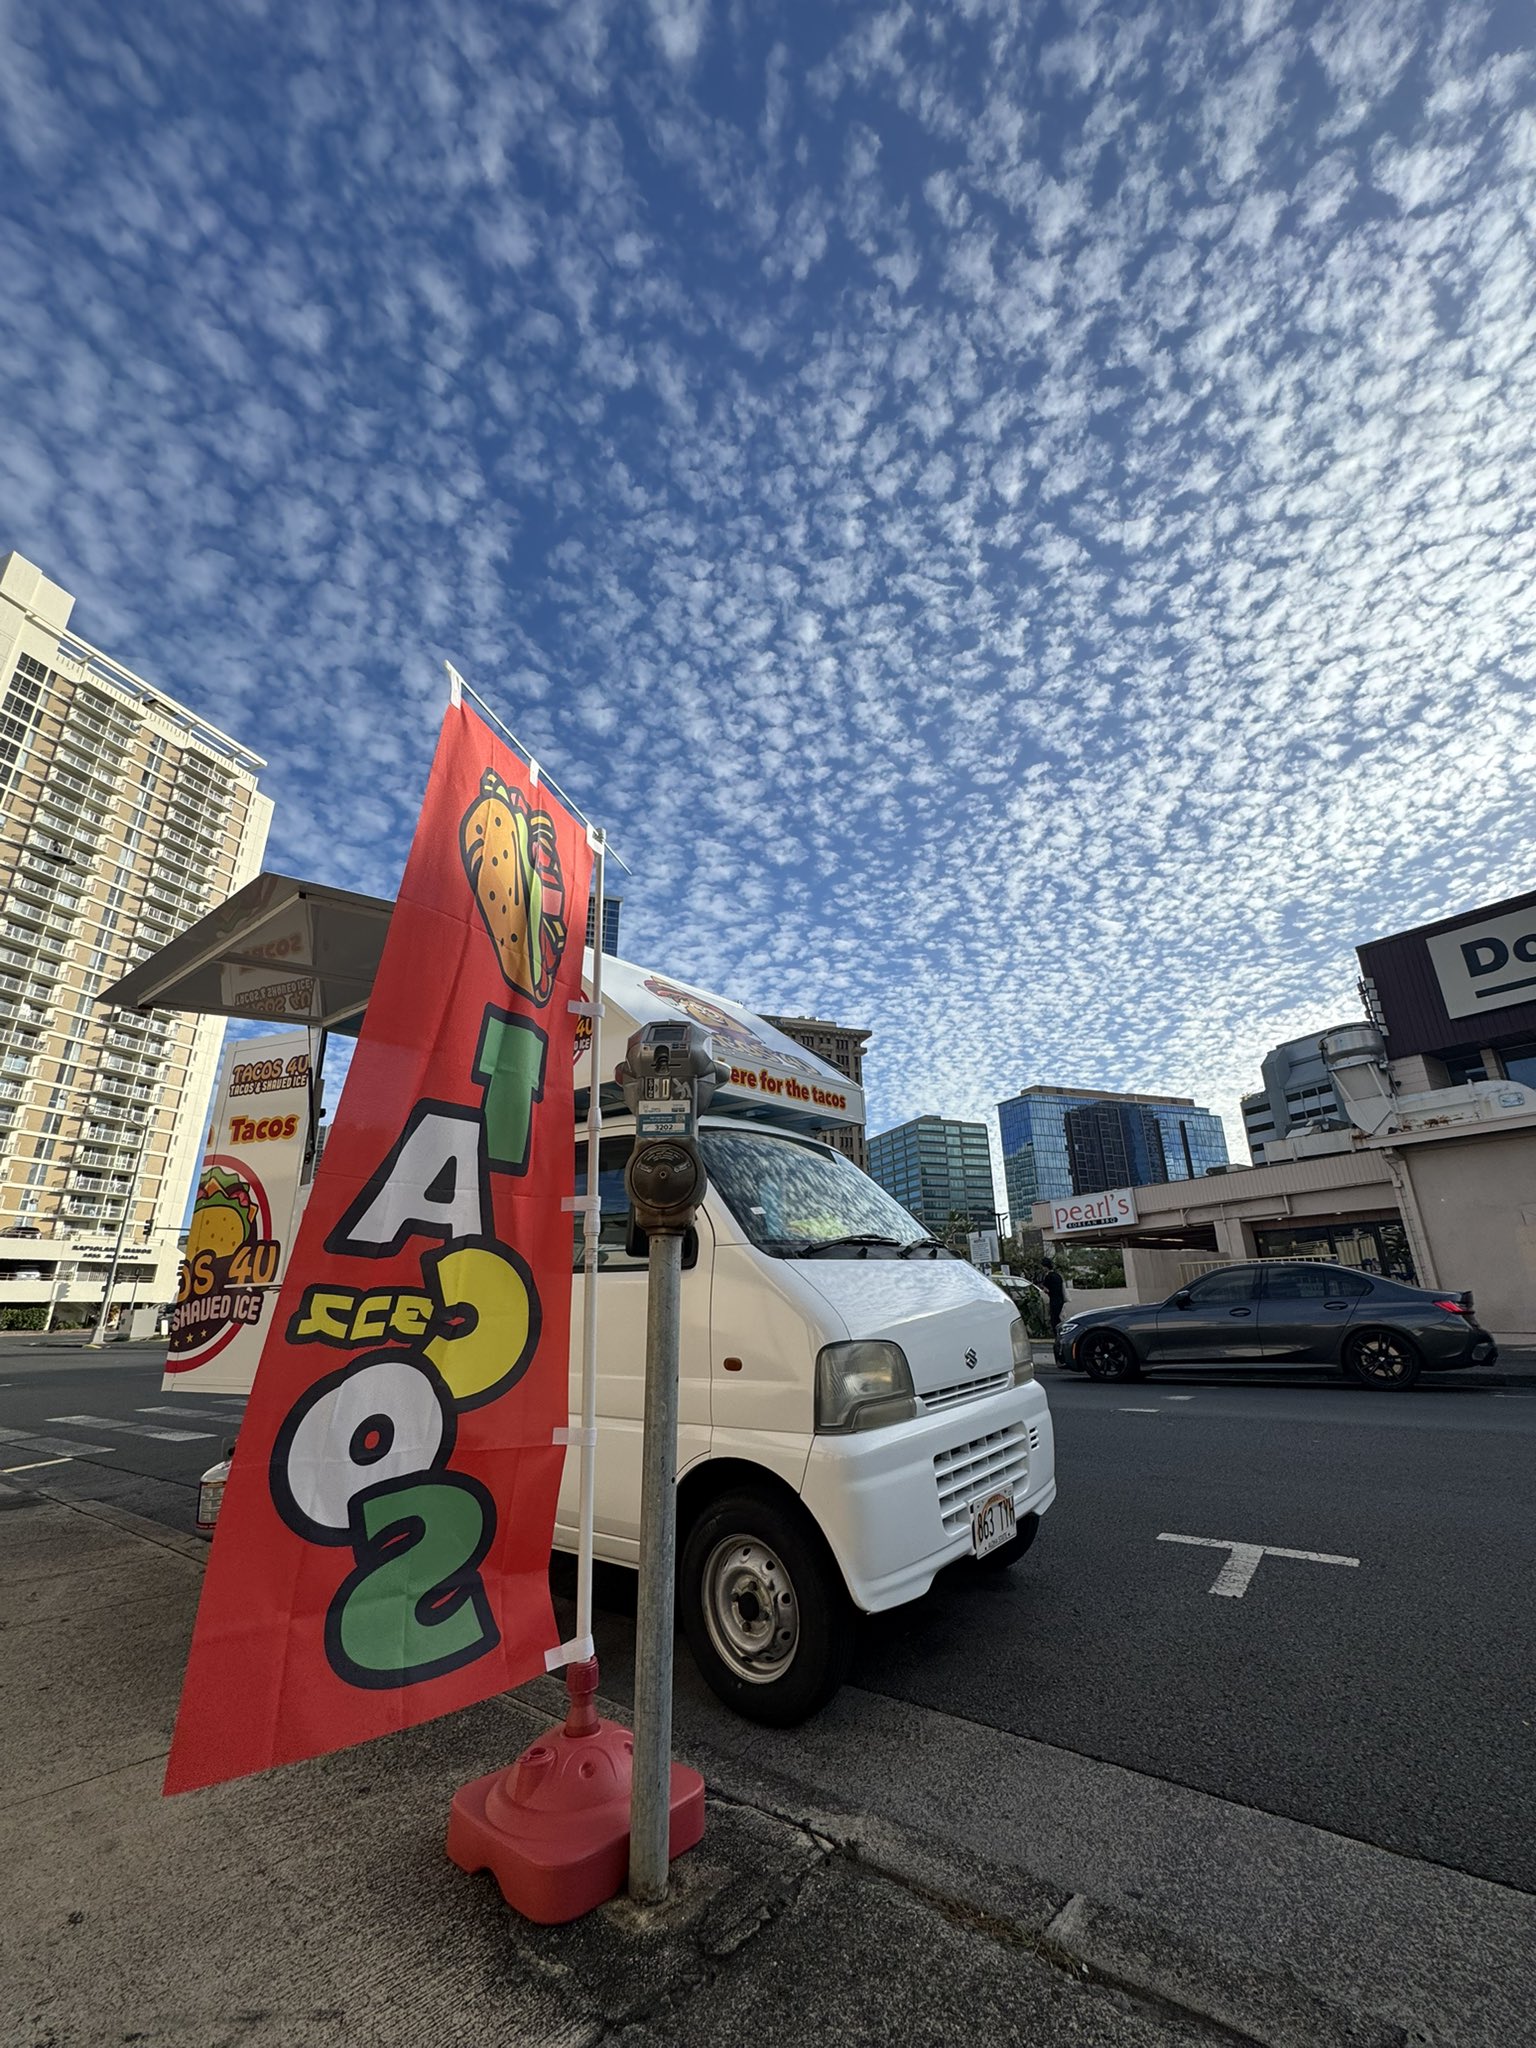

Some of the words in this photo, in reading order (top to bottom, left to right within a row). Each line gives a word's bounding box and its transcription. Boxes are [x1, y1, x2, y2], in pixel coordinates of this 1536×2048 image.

[229, 1082, 254, 1097] TACOS
[292, 1074, 307, 1087] ICE
[232, 1059, 284, 1084] TACOS
[729, 1064, 758, 1088] ere
[759, 1069, 783, 1095] for
[785, 1076, 810, 1100] the
[812, 1084, 848, 1110] tacos
[230, 1115, 299, 1144] Tacos
[1055, 1194, 1130, 1229] pearl's
[228, 1246, 278, 1286] 4U
[232, 1295, 262, 1322] ICE
[977, 1506, 995, 1543] 863
